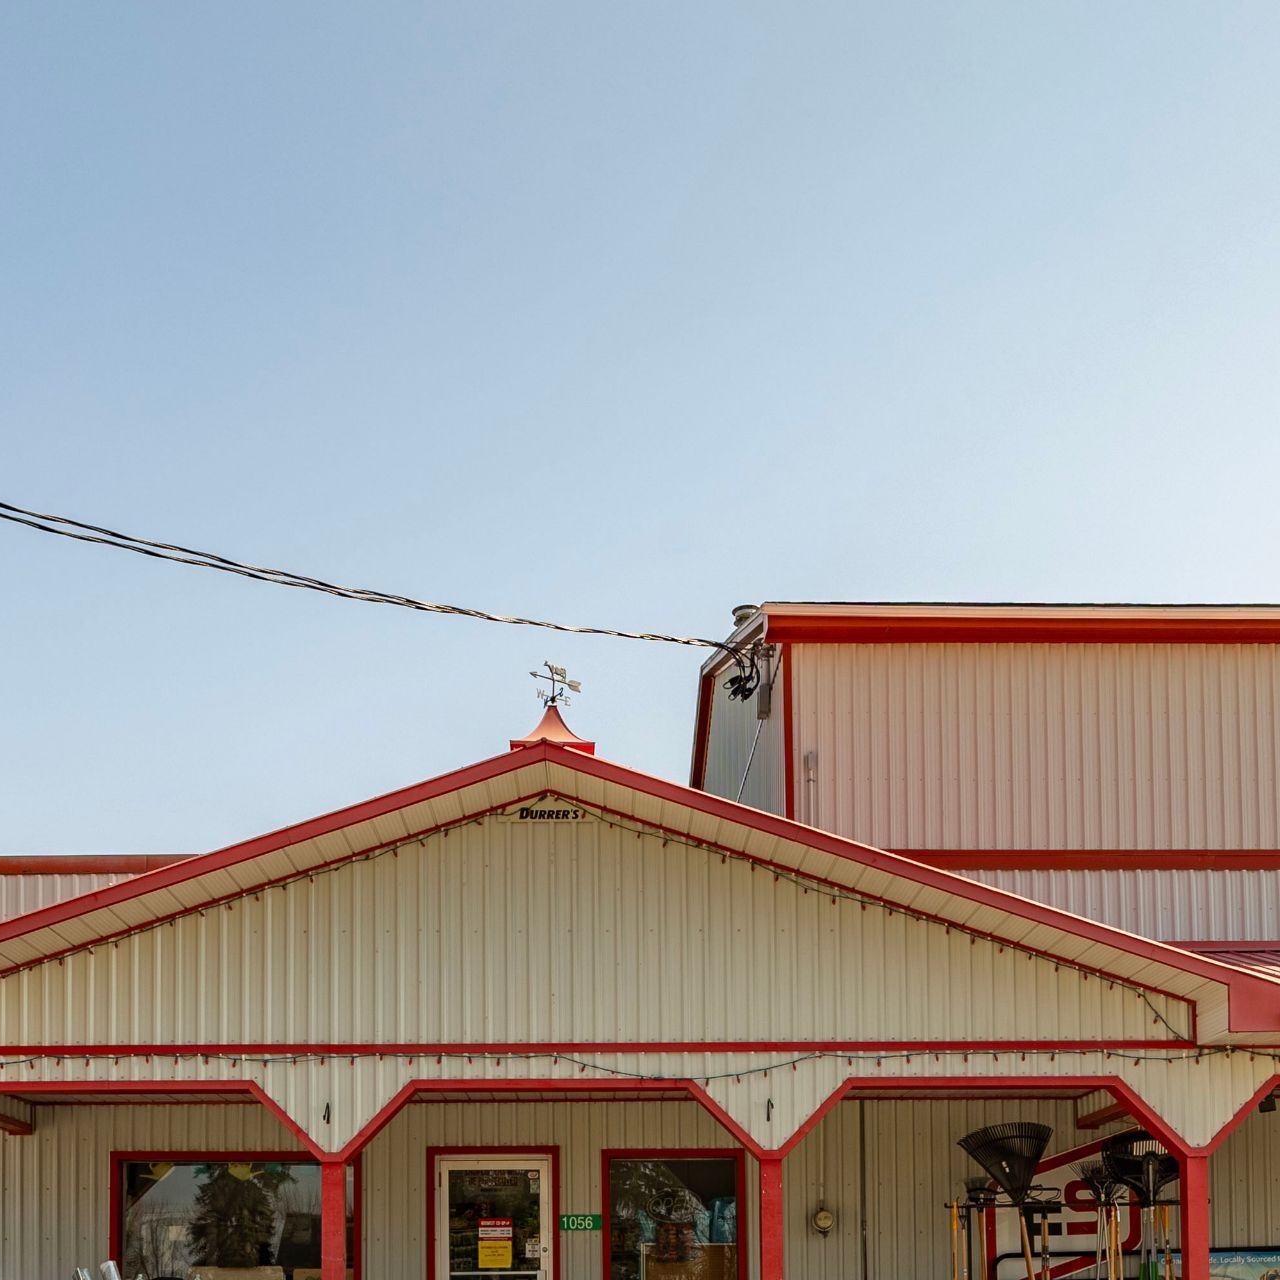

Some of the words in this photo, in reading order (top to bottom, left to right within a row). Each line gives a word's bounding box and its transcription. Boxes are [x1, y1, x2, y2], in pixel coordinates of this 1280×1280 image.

[562, 1216, 593, 1229] 1056
[1220, 1255, 1245, 1264] Locally
[1246, 1255, 1277, 1263] Sourced
